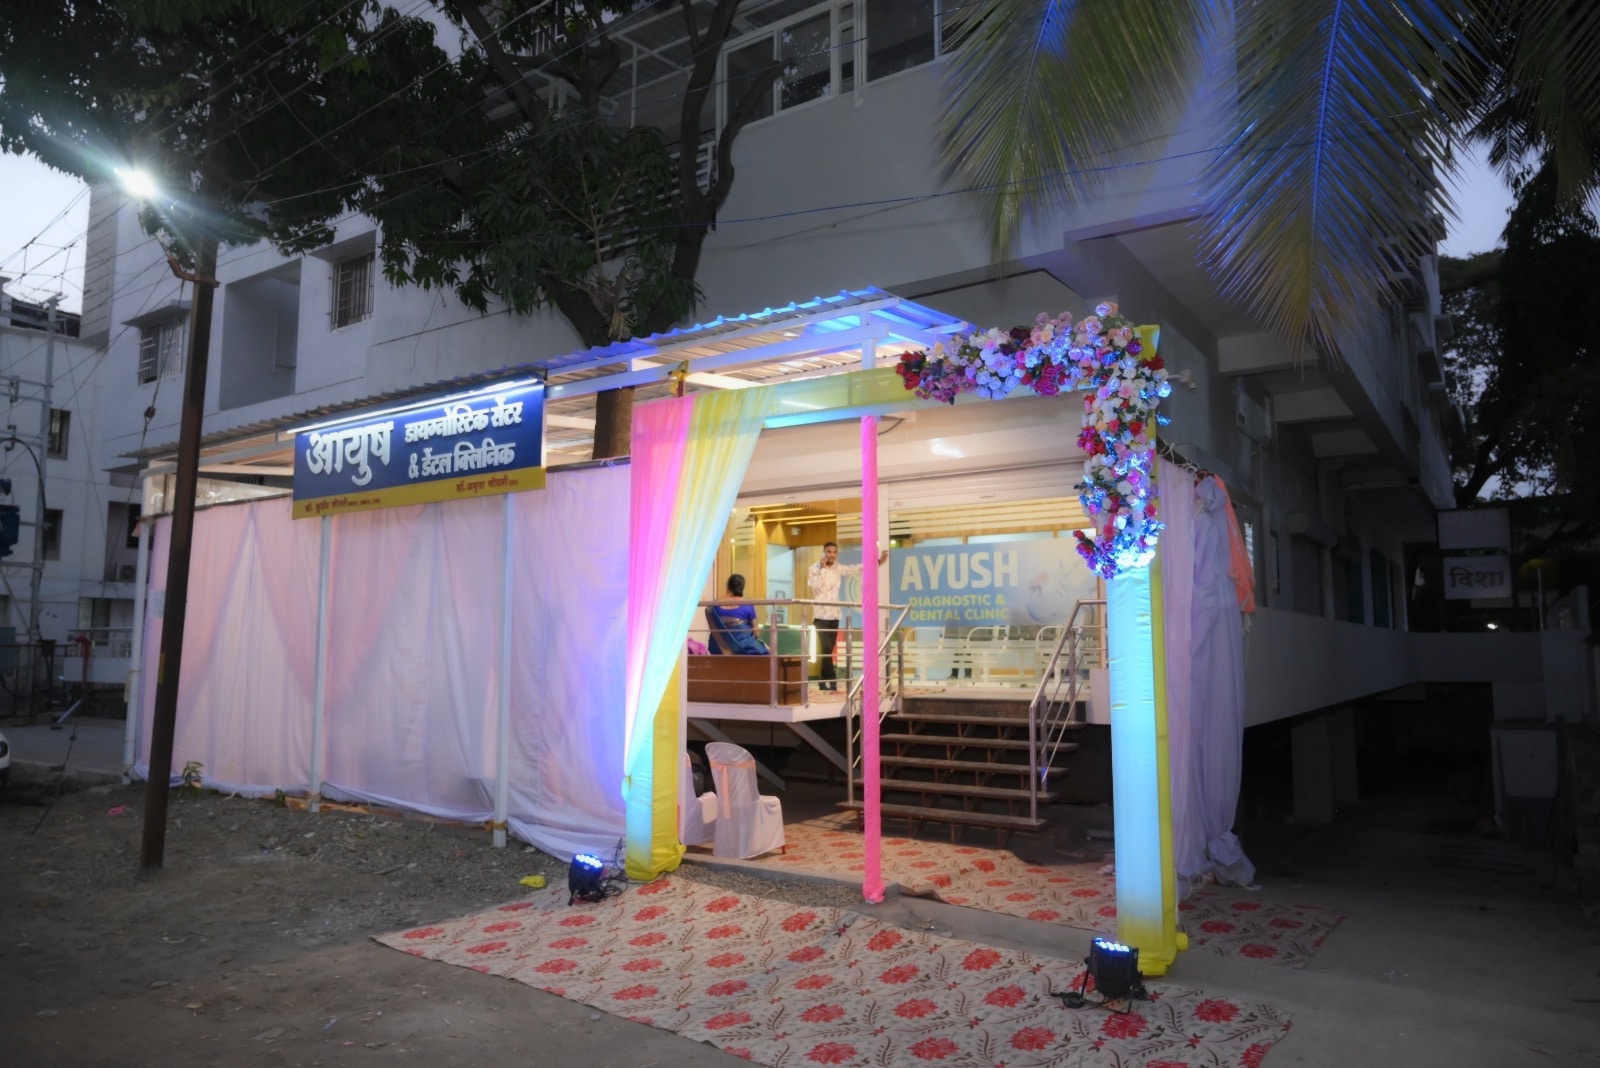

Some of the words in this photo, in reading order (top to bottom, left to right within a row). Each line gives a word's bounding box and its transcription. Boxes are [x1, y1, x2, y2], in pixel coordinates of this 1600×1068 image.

[306, 420, 394, 486] आयुष
[408, 452, 419, 479] &
[421, 447, 453, 477] डेंटल
[453, 437, 516, 472] क्लिनिक
[900, 549, 1018, 592] AYUSH
[909, 593, 992, 607] DIAGNOSTIC
[995, 593, 1006, 605] &
[910, 608, 962, 621] DENTAL
[964, 608, 1009, 621] CLINIC
